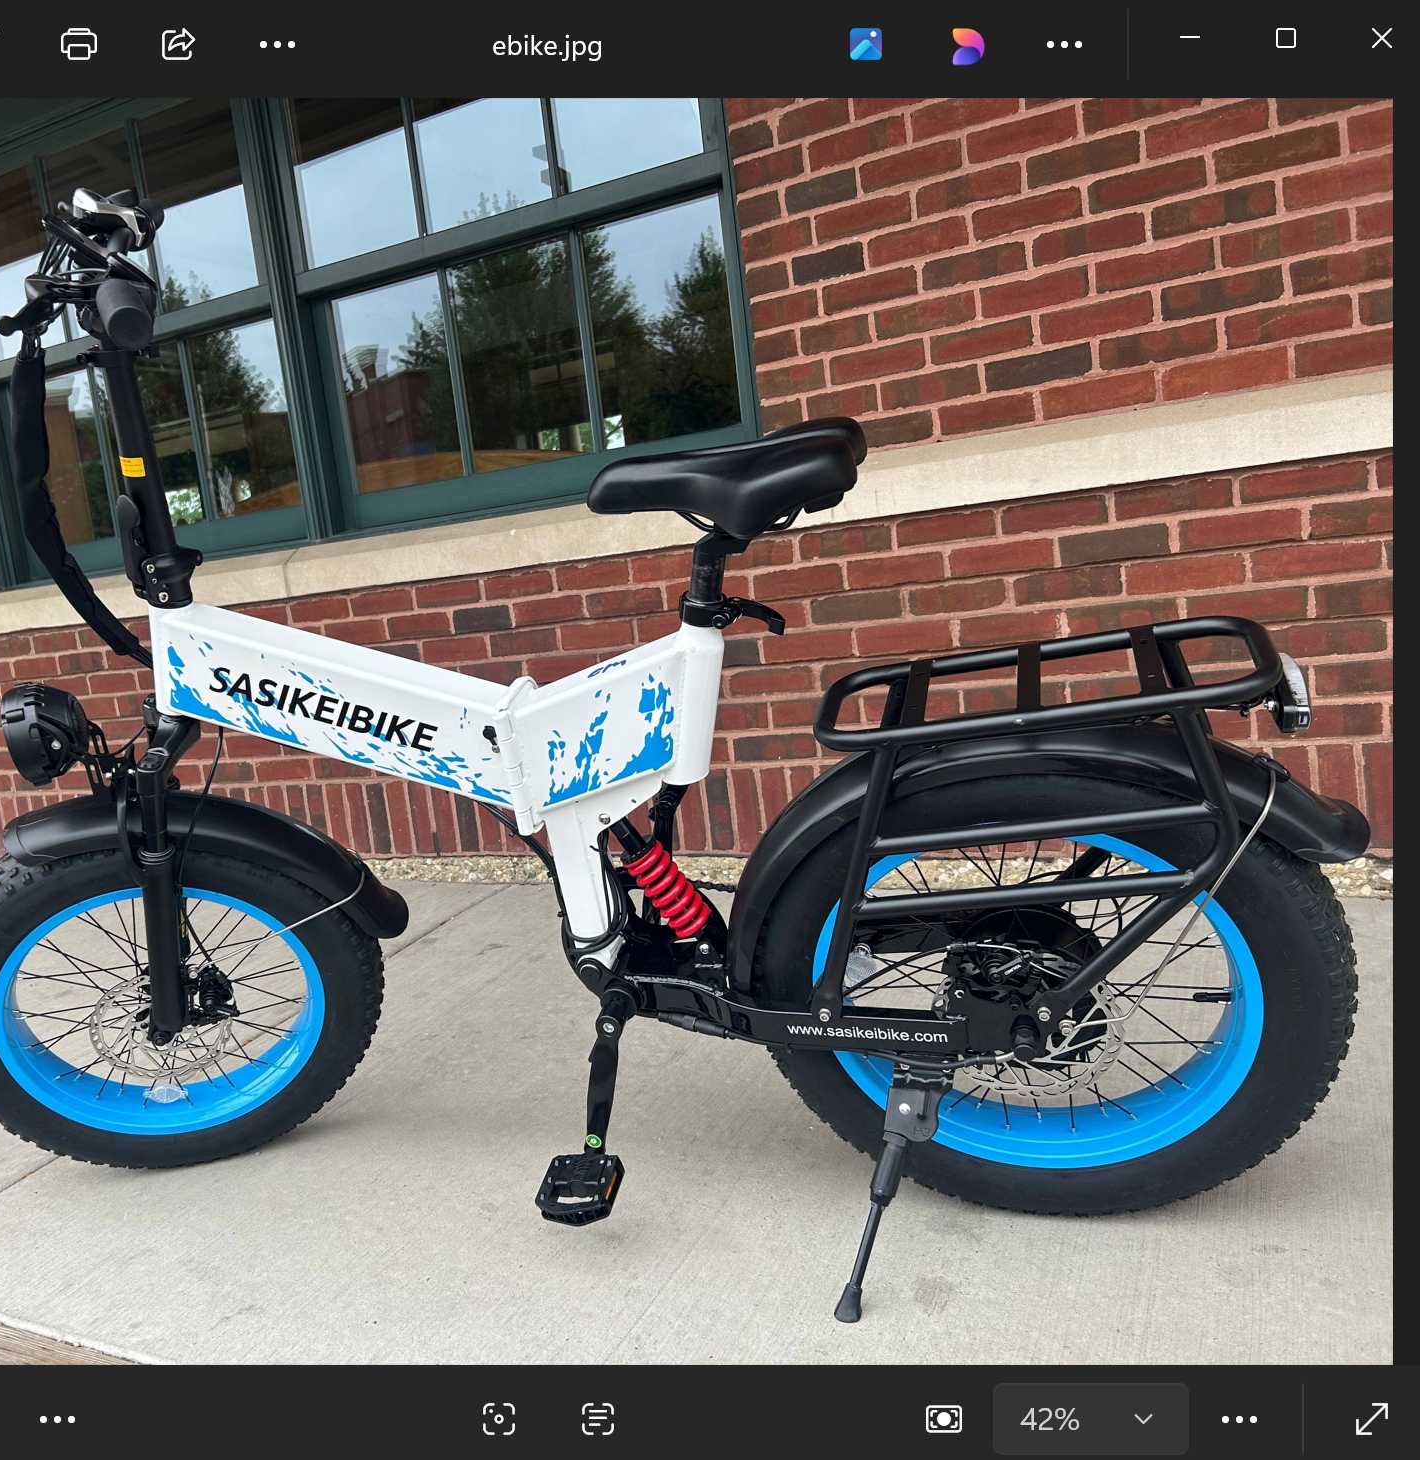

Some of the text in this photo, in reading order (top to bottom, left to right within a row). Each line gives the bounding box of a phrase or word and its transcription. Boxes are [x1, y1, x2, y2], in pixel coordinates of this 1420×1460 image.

[492, 33, 602, 62] ebike.jpg
[209, 666, 439, 752] SASIKEIBIKE
[786, 1024, 949, 1043] www.sasikeibike.com
[1019, 1407, 1080, 1431] 42%
